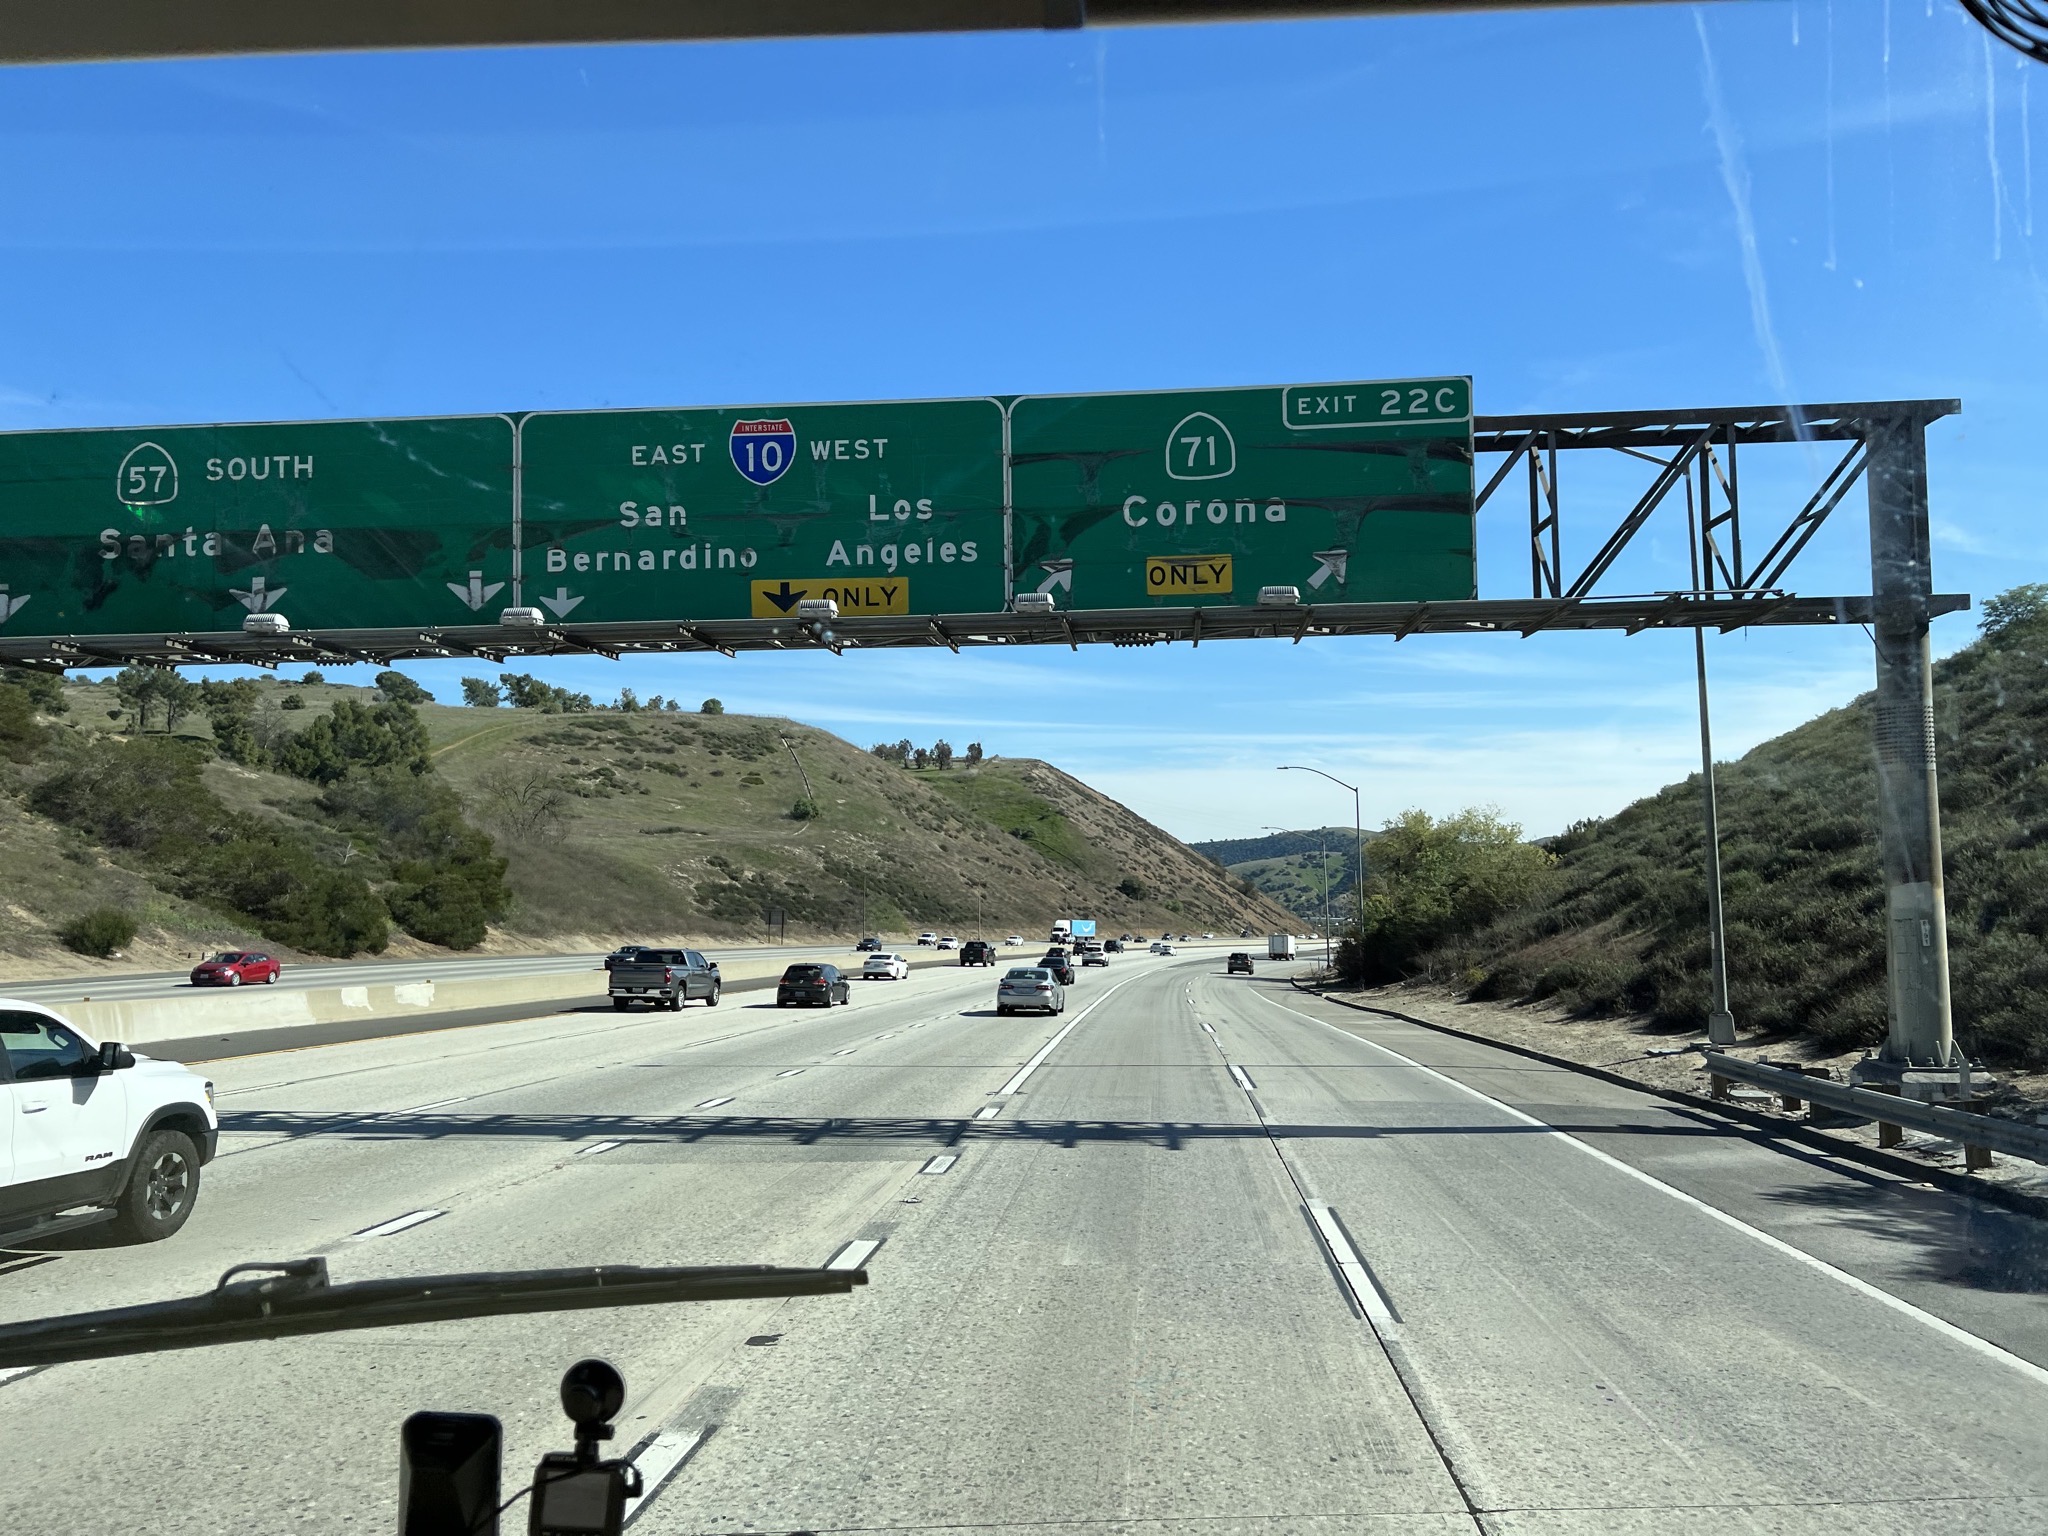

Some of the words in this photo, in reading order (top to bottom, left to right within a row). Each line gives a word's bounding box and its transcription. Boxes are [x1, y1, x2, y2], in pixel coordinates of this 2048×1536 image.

[1298, 395, 1357, 415] EXIT
[1381, 387, 1456, 415] 22C
[741, 424, 783, 432] INTERSTATE
[632, 443, 705, 466] EAST
[746, 441, 783, 472] 10
[810, 438, 888, 461] WEST
[1180, 435, 1216, 467] 71
[129, 466, 167, 494] 57
[206, 455, 313, 481] SOUTH
[619, 501, 687, 527] San
[869, 494, 933, 521] Los
[1123, 495, 1286, 527] Corona
[99, 526, 222, 560] Santa
[252, 524, 334, 555] Ana
[826, 537, 978, 573] Angeles
[547, 543, 758, 573] Bernardino
[1149, 563, 1228, 587] ONLY
[85, 1151, 113, 1162] RAM
